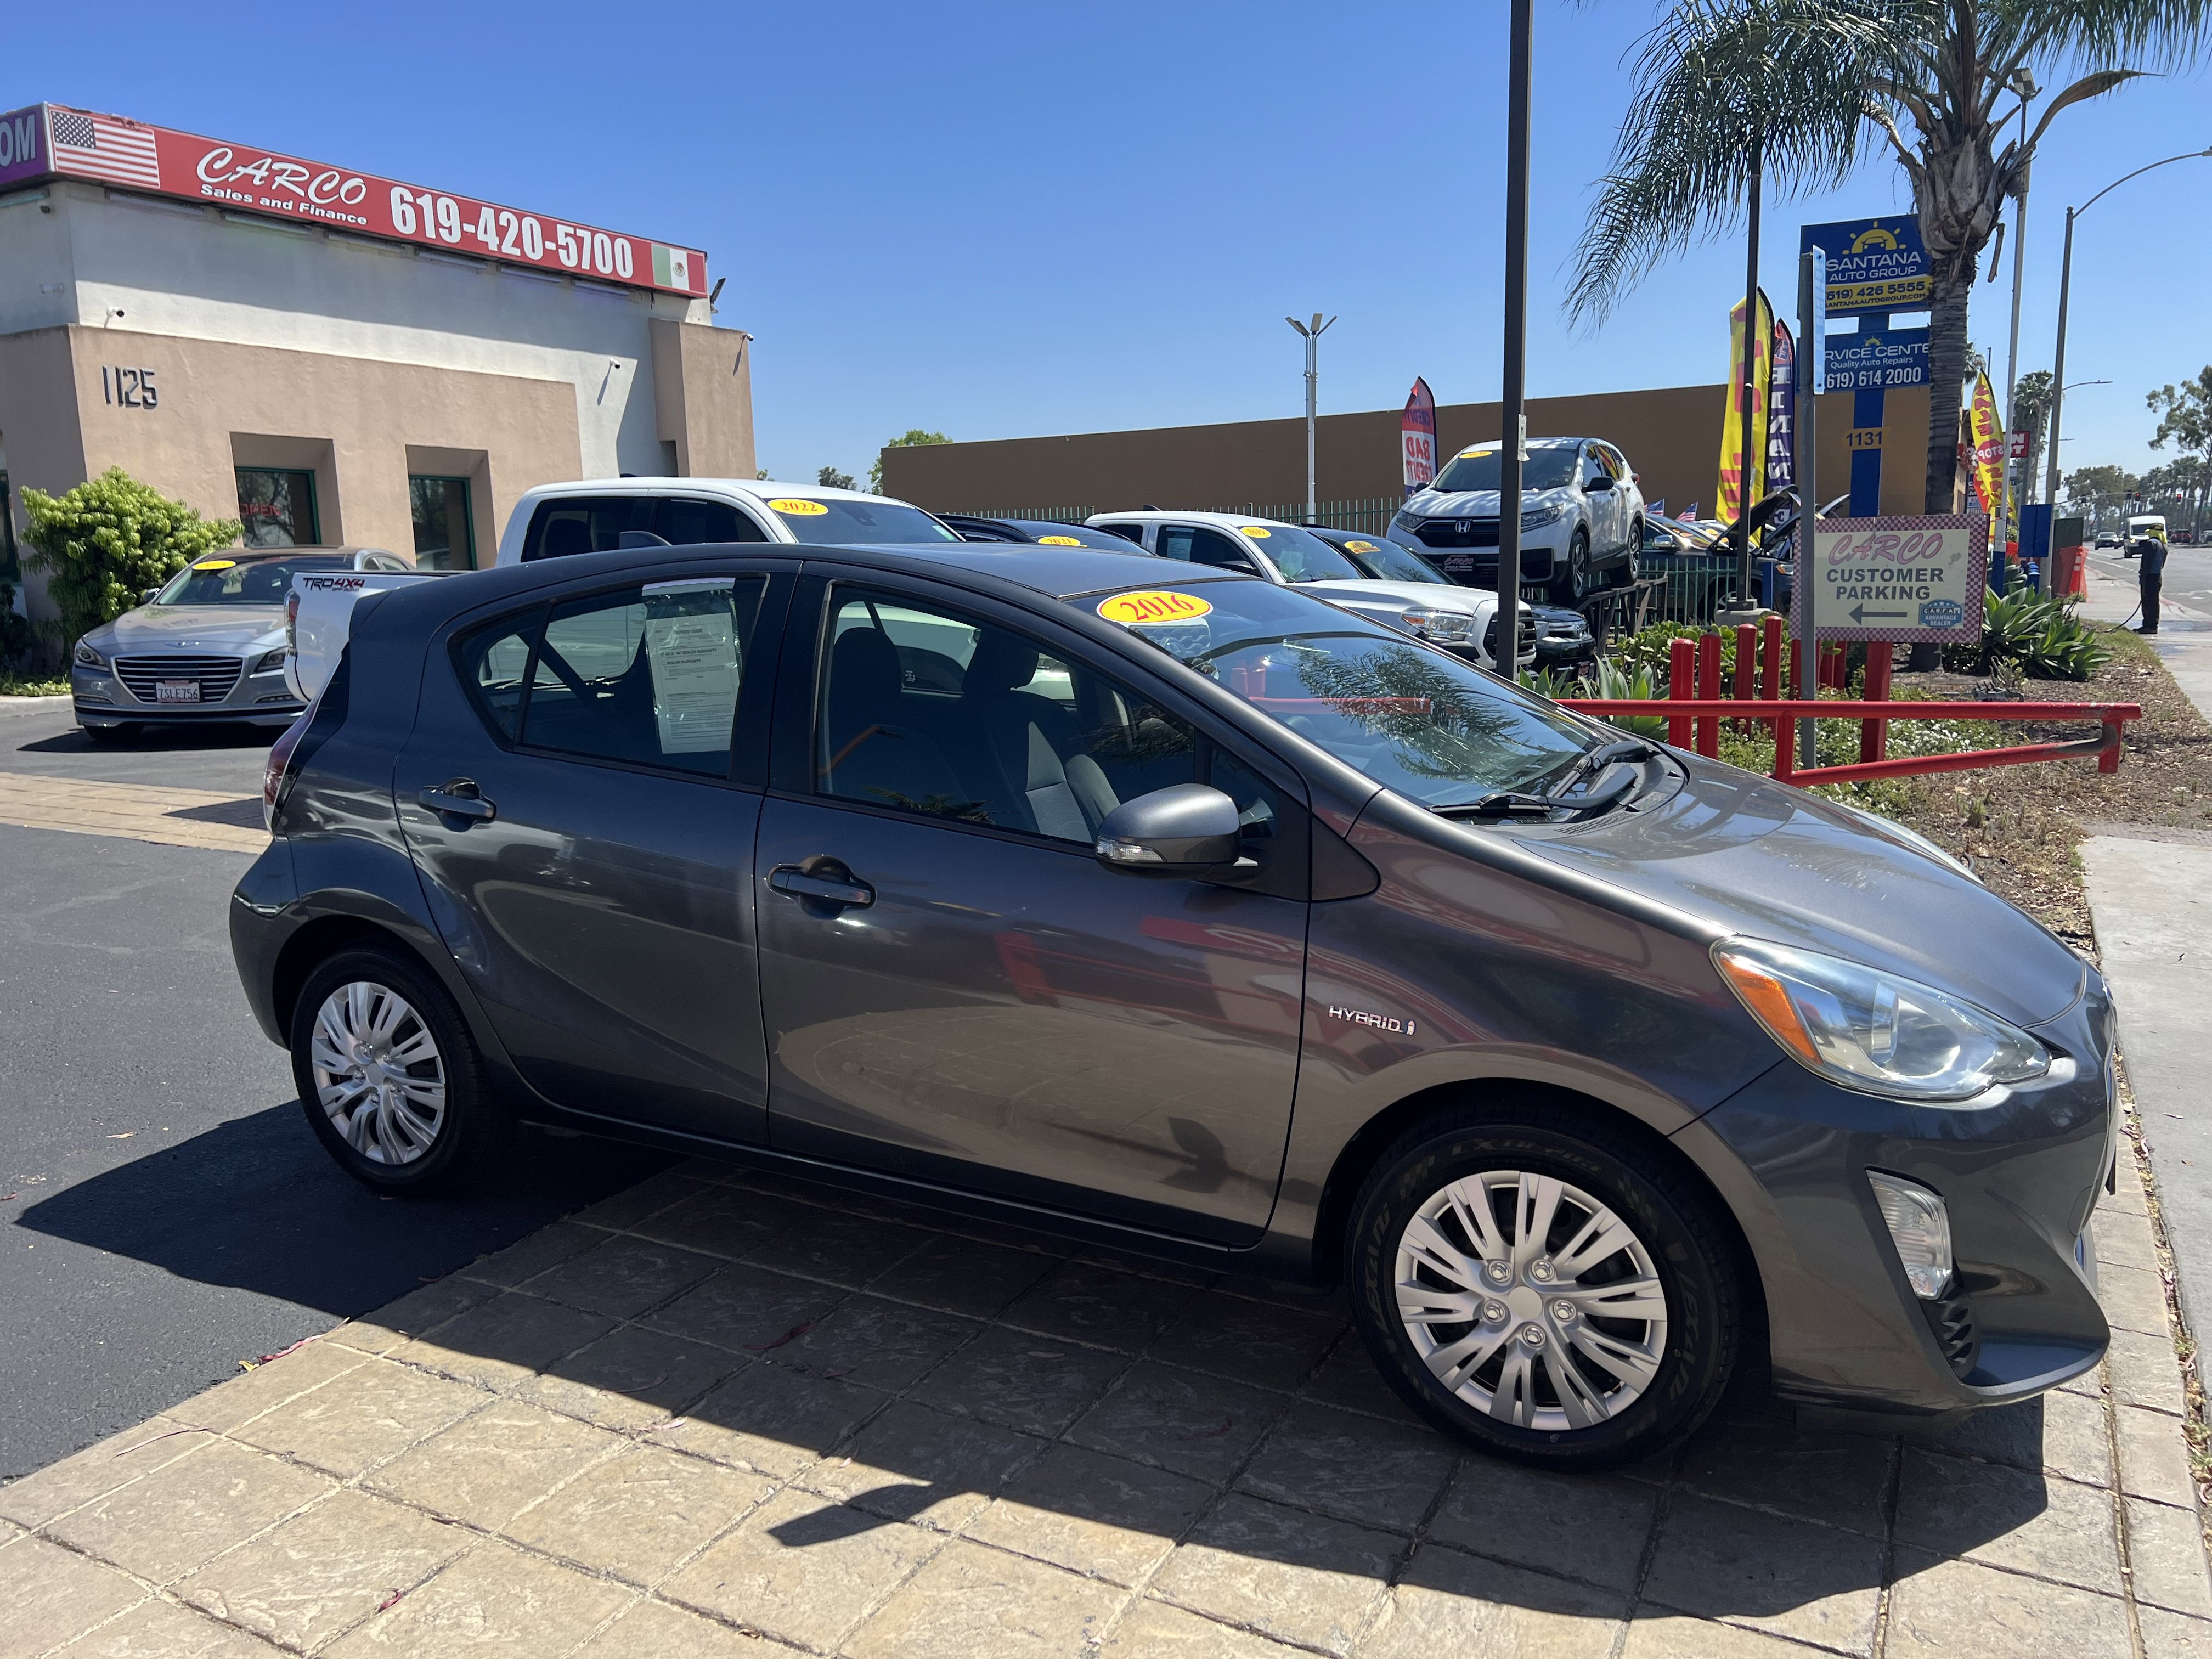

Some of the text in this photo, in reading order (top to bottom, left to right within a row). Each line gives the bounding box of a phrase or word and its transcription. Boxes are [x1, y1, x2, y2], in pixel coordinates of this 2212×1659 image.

[196, 147, 366, 205] CARCO
[200, 184, 368, 225] Sales and Finance
[390, 186, 634, 278] 619-420-5700
[1826, 251, 1922, 272] SANTANA
[1829, 266, 1917, 282] AUTO GROUP
[1857, 286, 1884, 297] 426
[1887, 281, 1925, 294] 5555
[1825, 343, 1929, 361] RVICE CENTE
[1831, 360, 1860, 370] Quality
[1882, 357, 1914, 366] Repairs
[1859, 369, 1882, 386] 614
[1886, 366, 1922, 385] 2000
[102, 364, 158, 409] 1125
[1846, 431, 1883, 447] 1131
[781, 501, 817, 511] 2022
[1828, 532, 1943, 566] CARCO
[1826, 568, 1944, 583] CUSTOMER
[1836, 586, 1931, 600] PARKING
[1120, 594, 1194, 621] 2016
[1328, 1005, 1401, 1032] HYBRID
